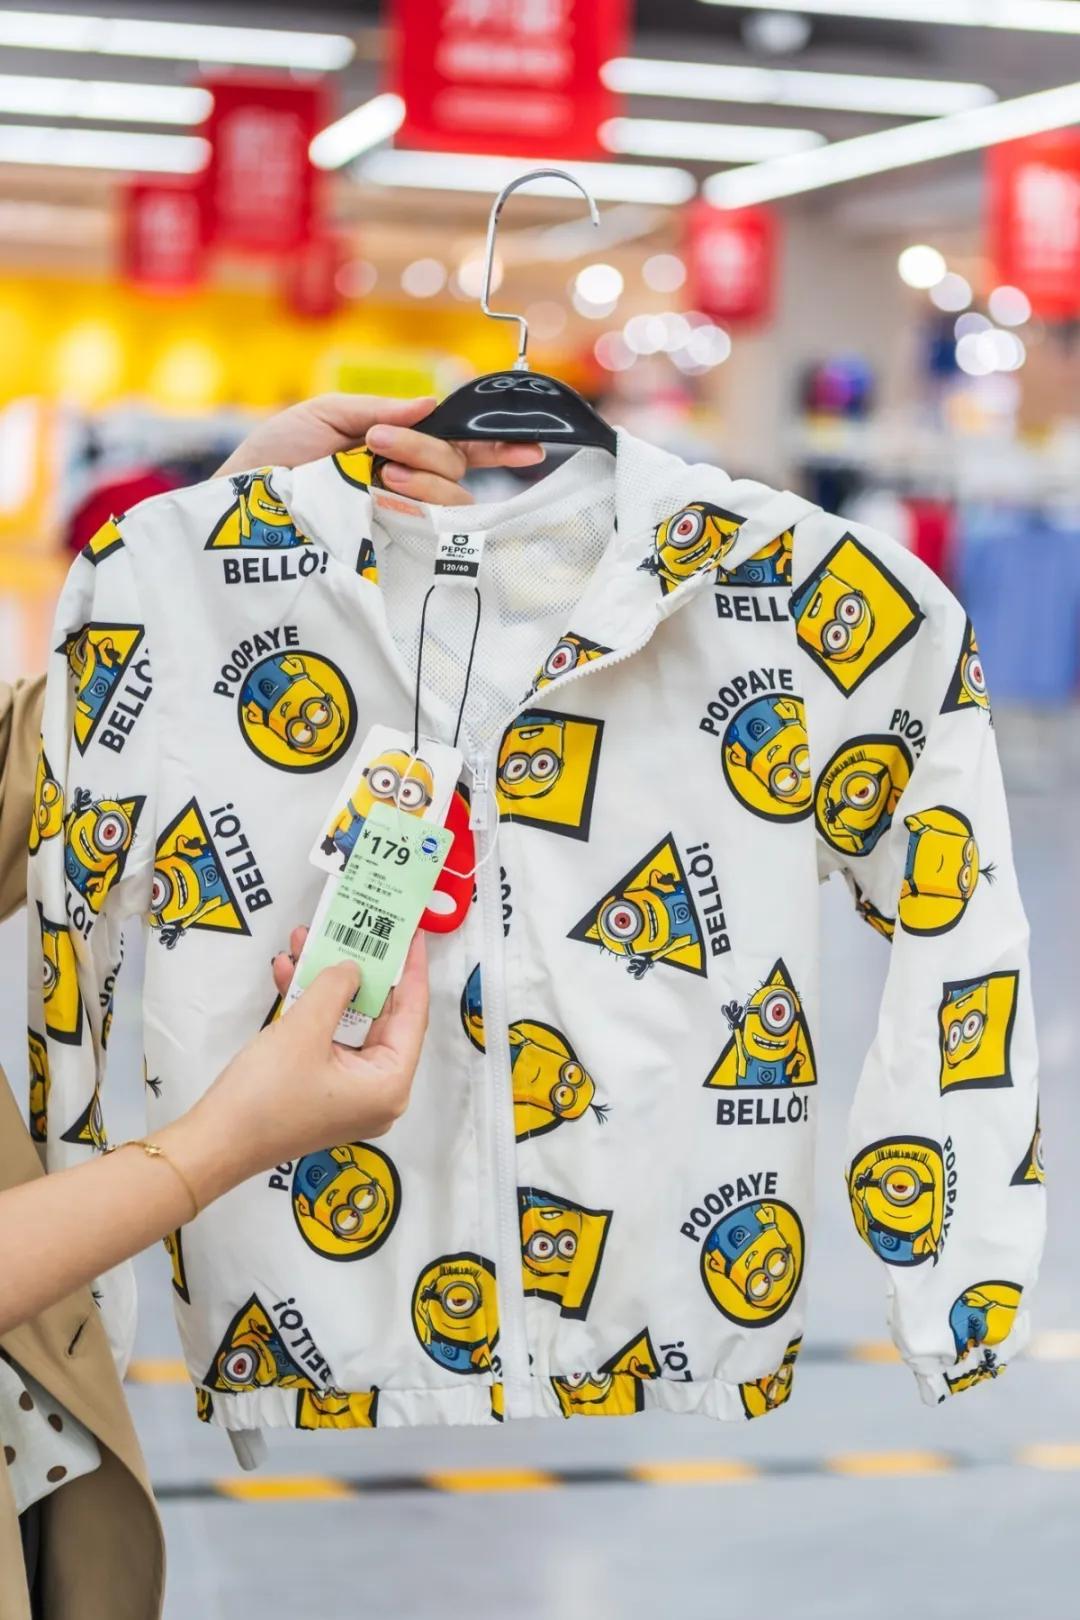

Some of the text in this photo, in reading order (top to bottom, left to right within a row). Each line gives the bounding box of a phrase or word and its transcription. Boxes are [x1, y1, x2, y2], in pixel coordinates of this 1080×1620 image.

[442, 563, 469, 572] 120/60
[213, 625, 300, 699] POOPAYE
[699, 668, 794, 737] POOPAYE
[352, 908, 396, 941] 小童
[680, 1171, 778, 1243] POOPAYE
